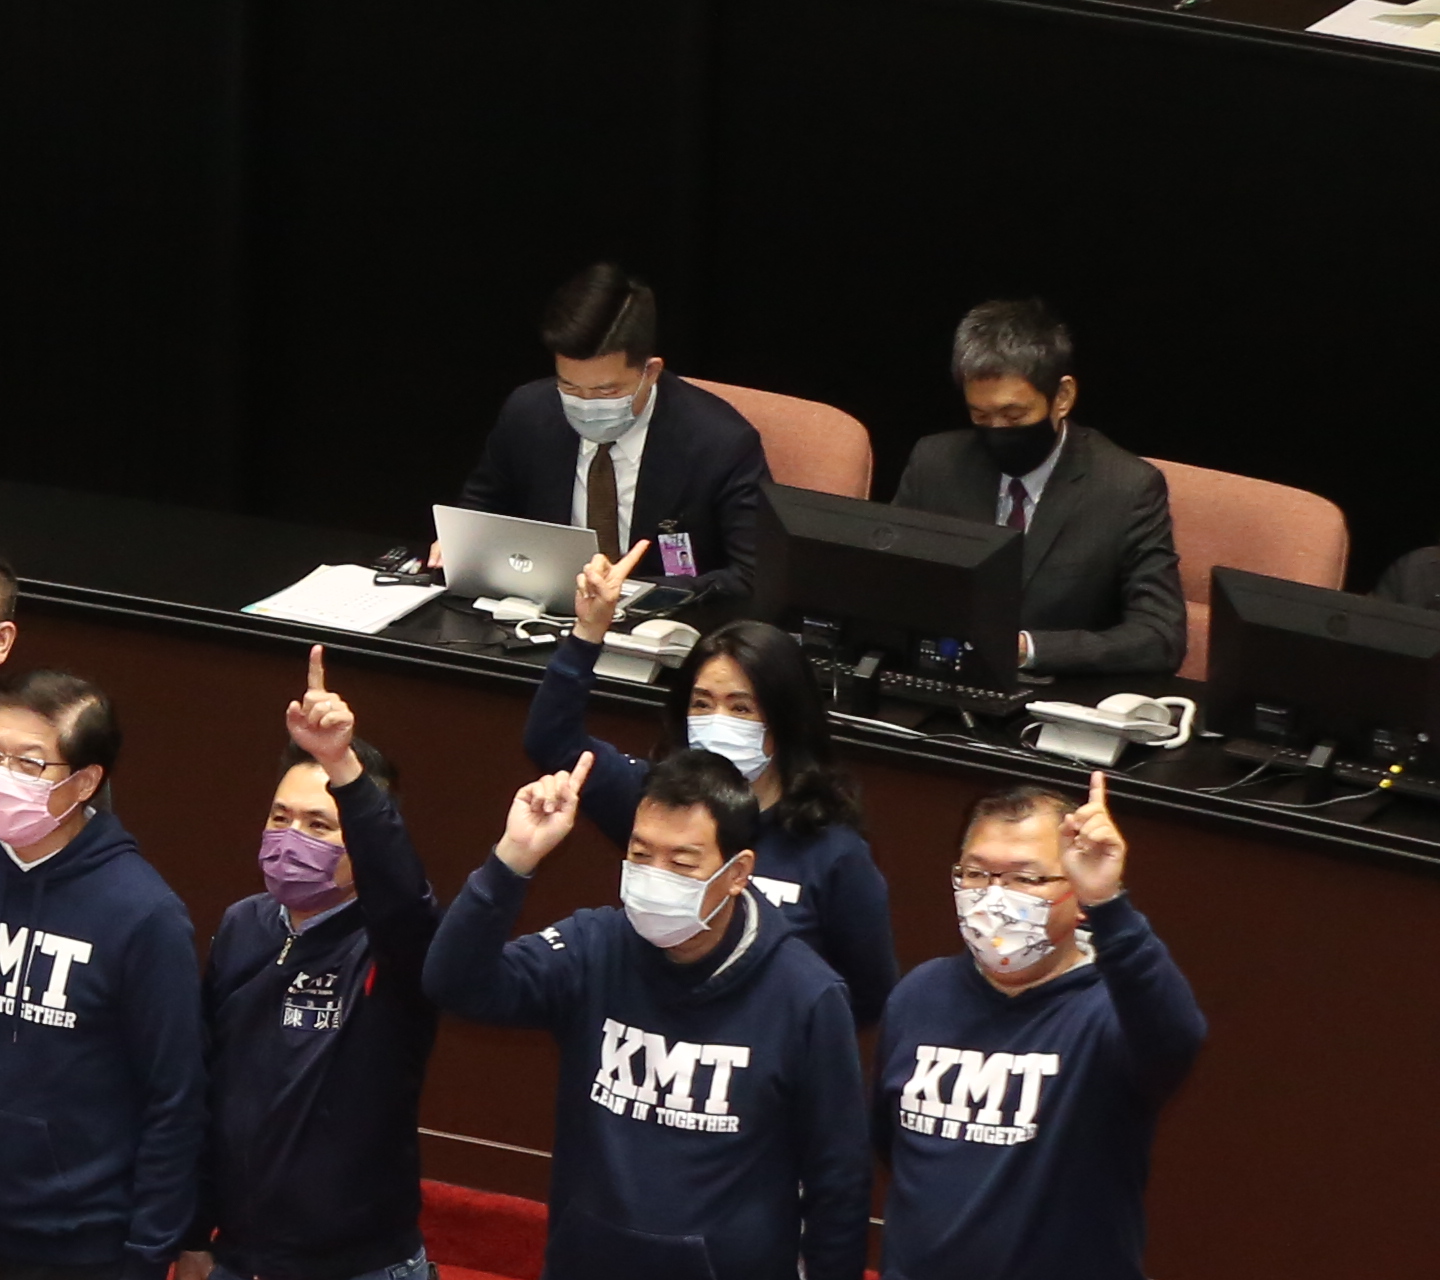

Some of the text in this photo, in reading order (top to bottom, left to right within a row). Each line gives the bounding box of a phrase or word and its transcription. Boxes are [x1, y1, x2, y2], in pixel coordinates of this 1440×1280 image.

[594, 1017, 751, 1115] KMT
[900, 1045, 1060, 1127] KMT
[589, 1082, 741, 1133] LEAN IN TOGETHER
[899, 1109, 937, 1136] LEAN
[940, 1119, 962, 1140] IN
